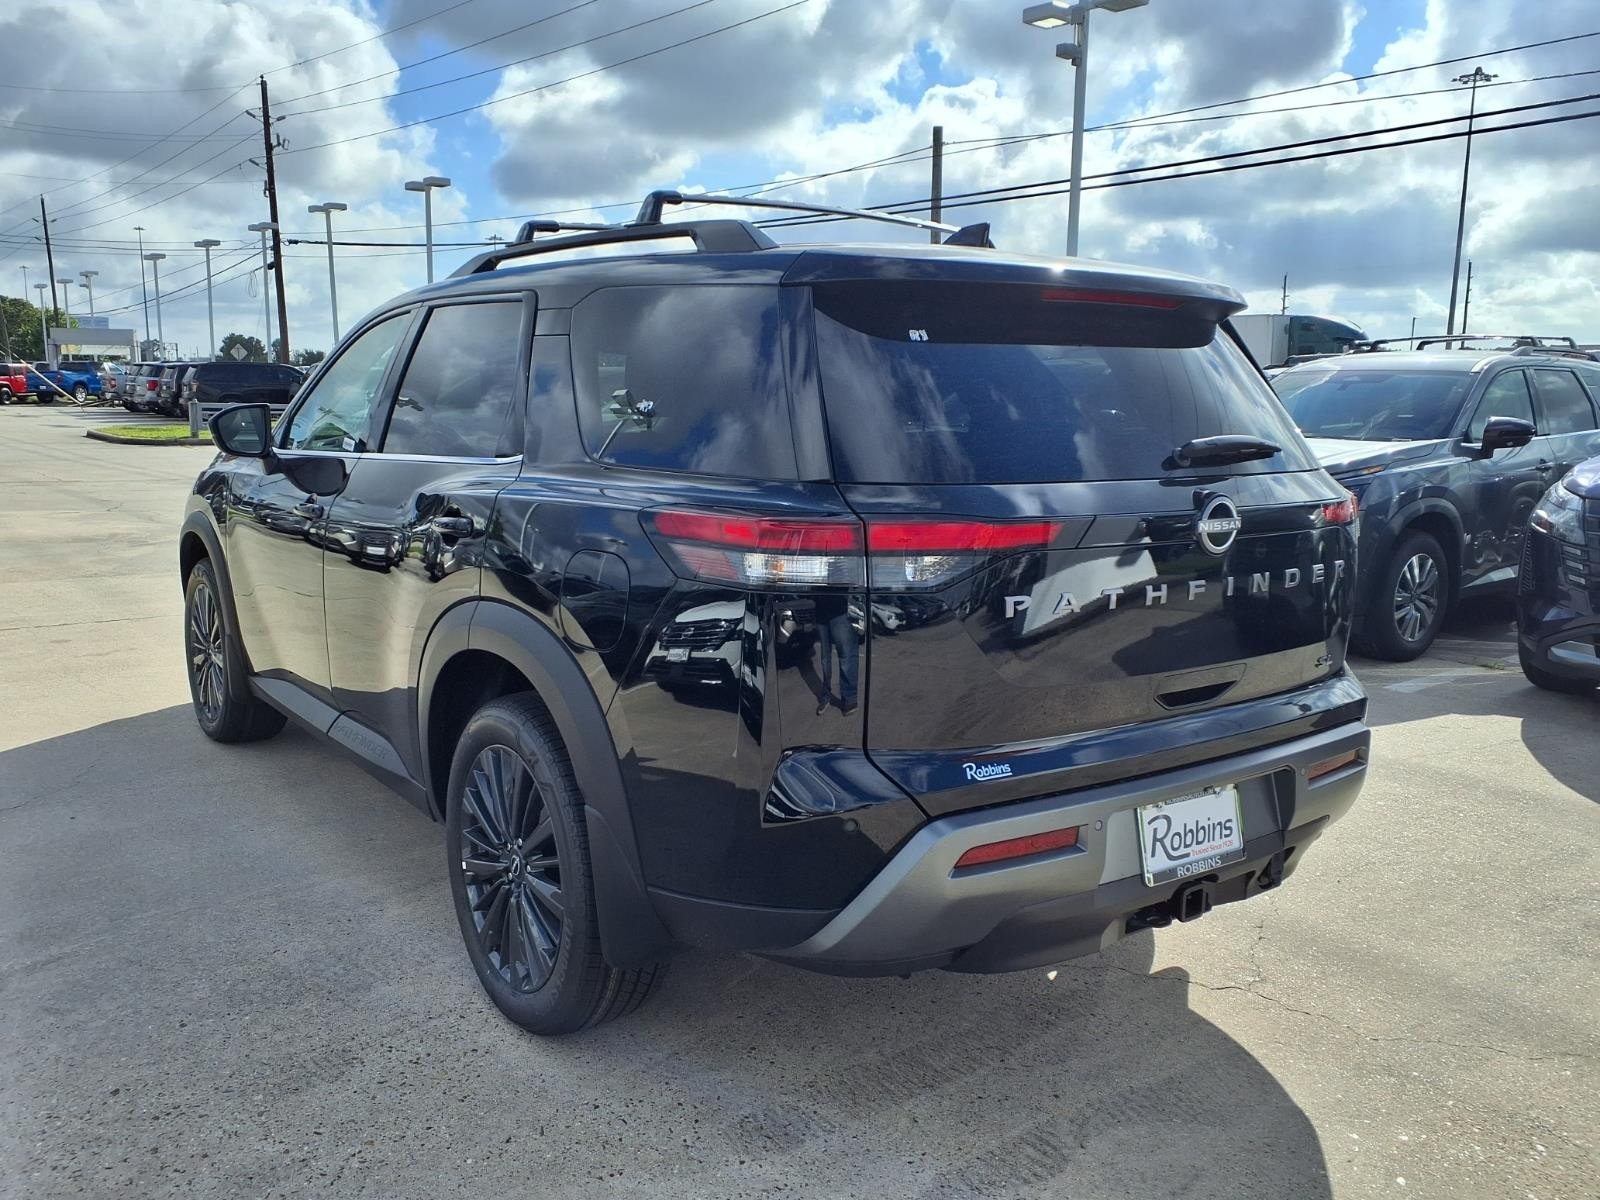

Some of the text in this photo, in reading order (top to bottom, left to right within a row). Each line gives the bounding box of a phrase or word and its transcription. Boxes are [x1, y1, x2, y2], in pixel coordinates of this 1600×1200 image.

[1199, 519, 1241, 531] NISSAN
[1004, 559, 1346, 618] PATHFINDER
[962, 762, 1013, 781] Robbins
[1147, 814, 1234, 861] Robbins
[1176, 855, 1222, 877] ROBBINS
